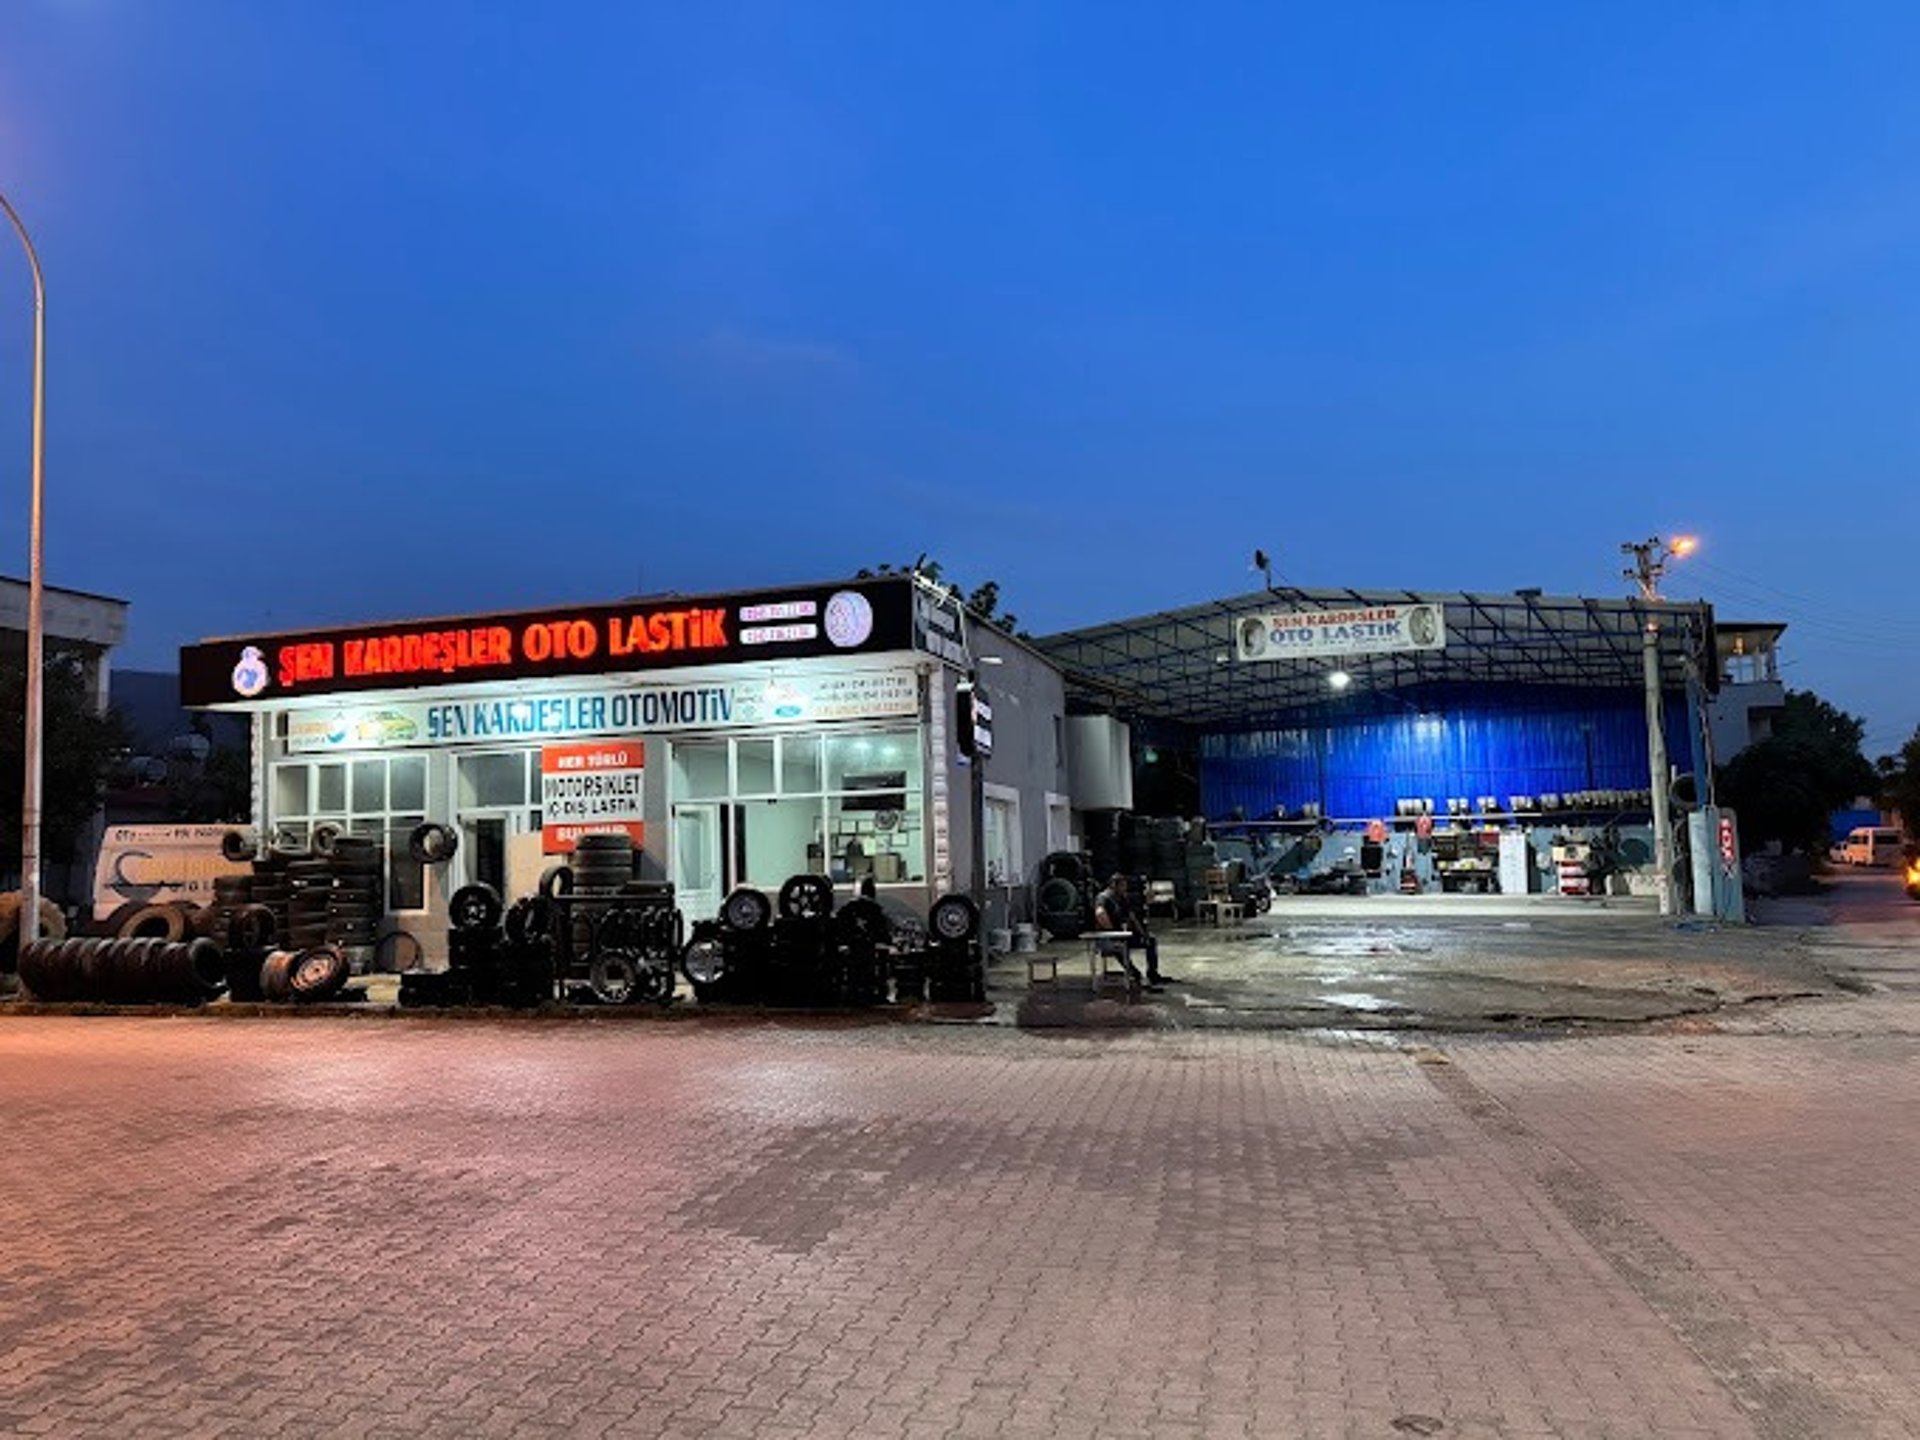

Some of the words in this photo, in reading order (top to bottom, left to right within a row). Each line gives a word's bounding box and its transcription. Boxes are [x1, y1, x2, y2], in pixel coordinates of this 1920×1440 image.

[279, 643, 334, 687] ŞEN
[344, 626, 511, 673] KARDEŞLER
[522, 620, 598, 661] OTO
[609, 608, 728, 655] LASTİK
[1270, 628, 1313, 645] OTO
[612, 688, 734, 727] OTOMOTİV
